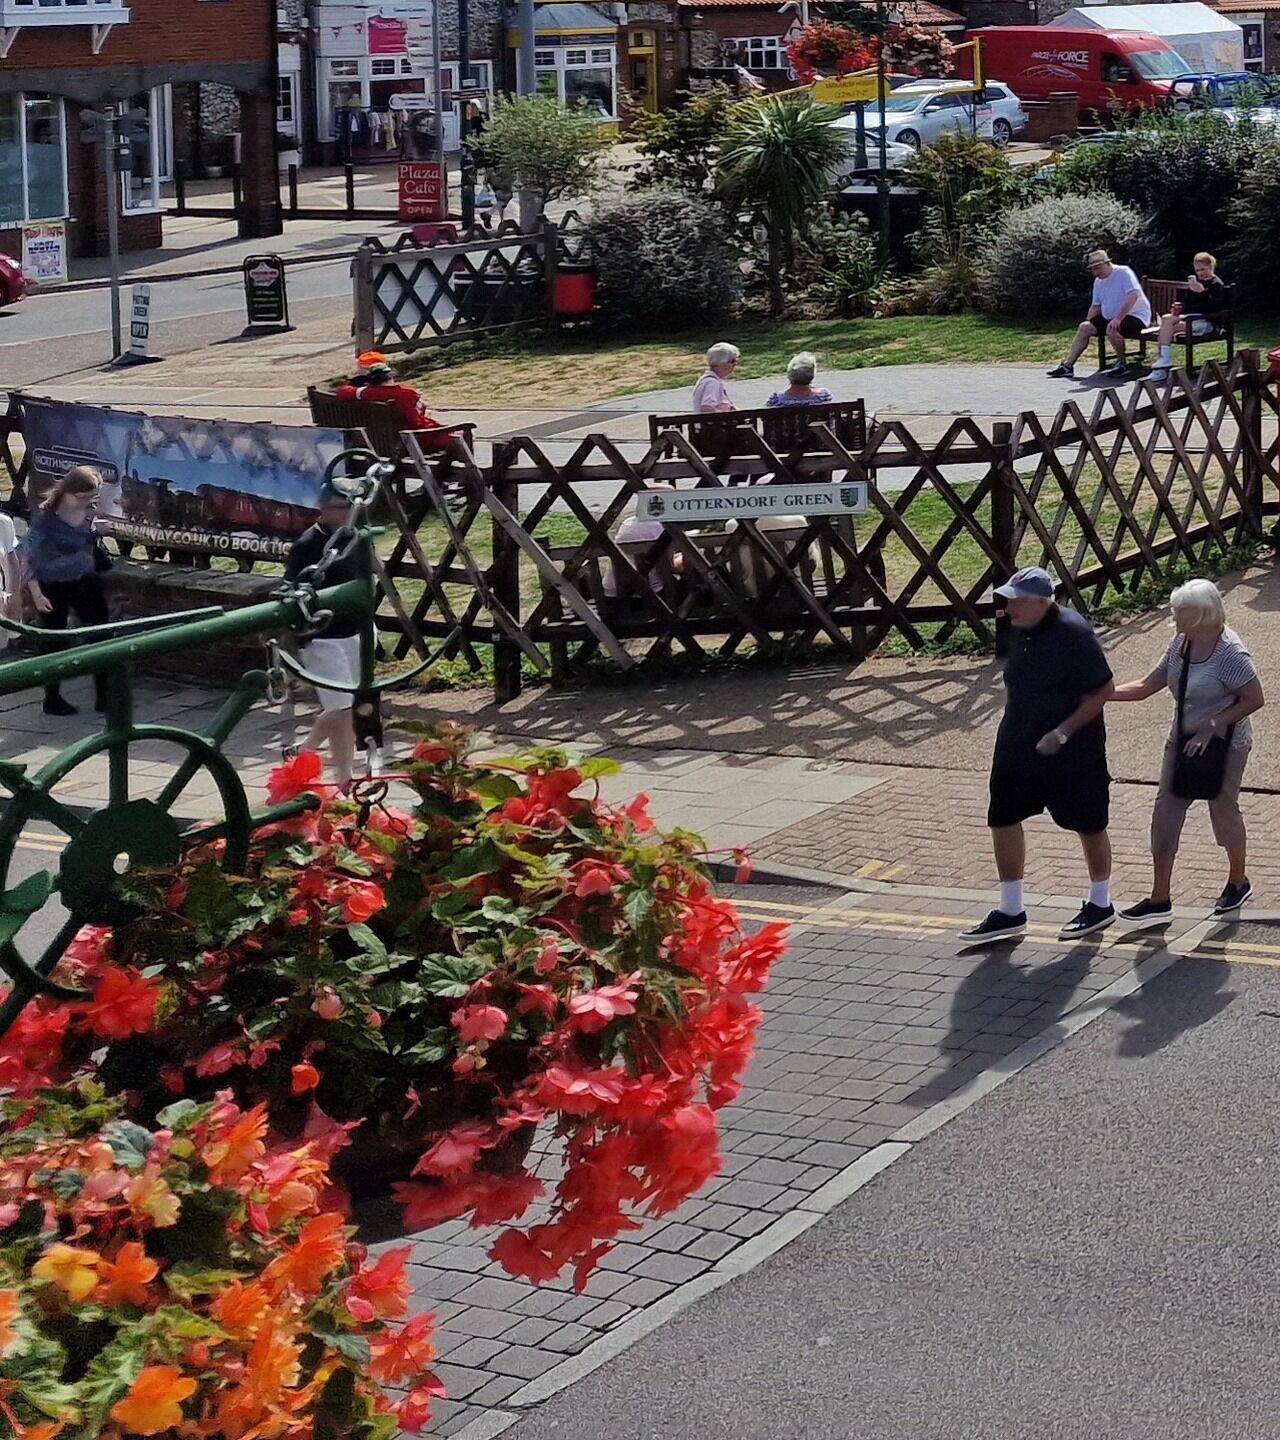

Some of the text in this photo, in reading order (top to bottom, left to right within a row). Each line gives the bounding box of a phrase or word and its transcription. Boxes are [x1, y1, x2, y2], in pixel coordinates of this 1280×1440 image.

[400, 165, 441, 179] Plaza
[407, 206, 433, 214] OPEN
[672, 493, 833, 512] OTTERNDORF GREEN
[213, 537, 229, 548] TO
[231, 537, 269, 553] BOOK
